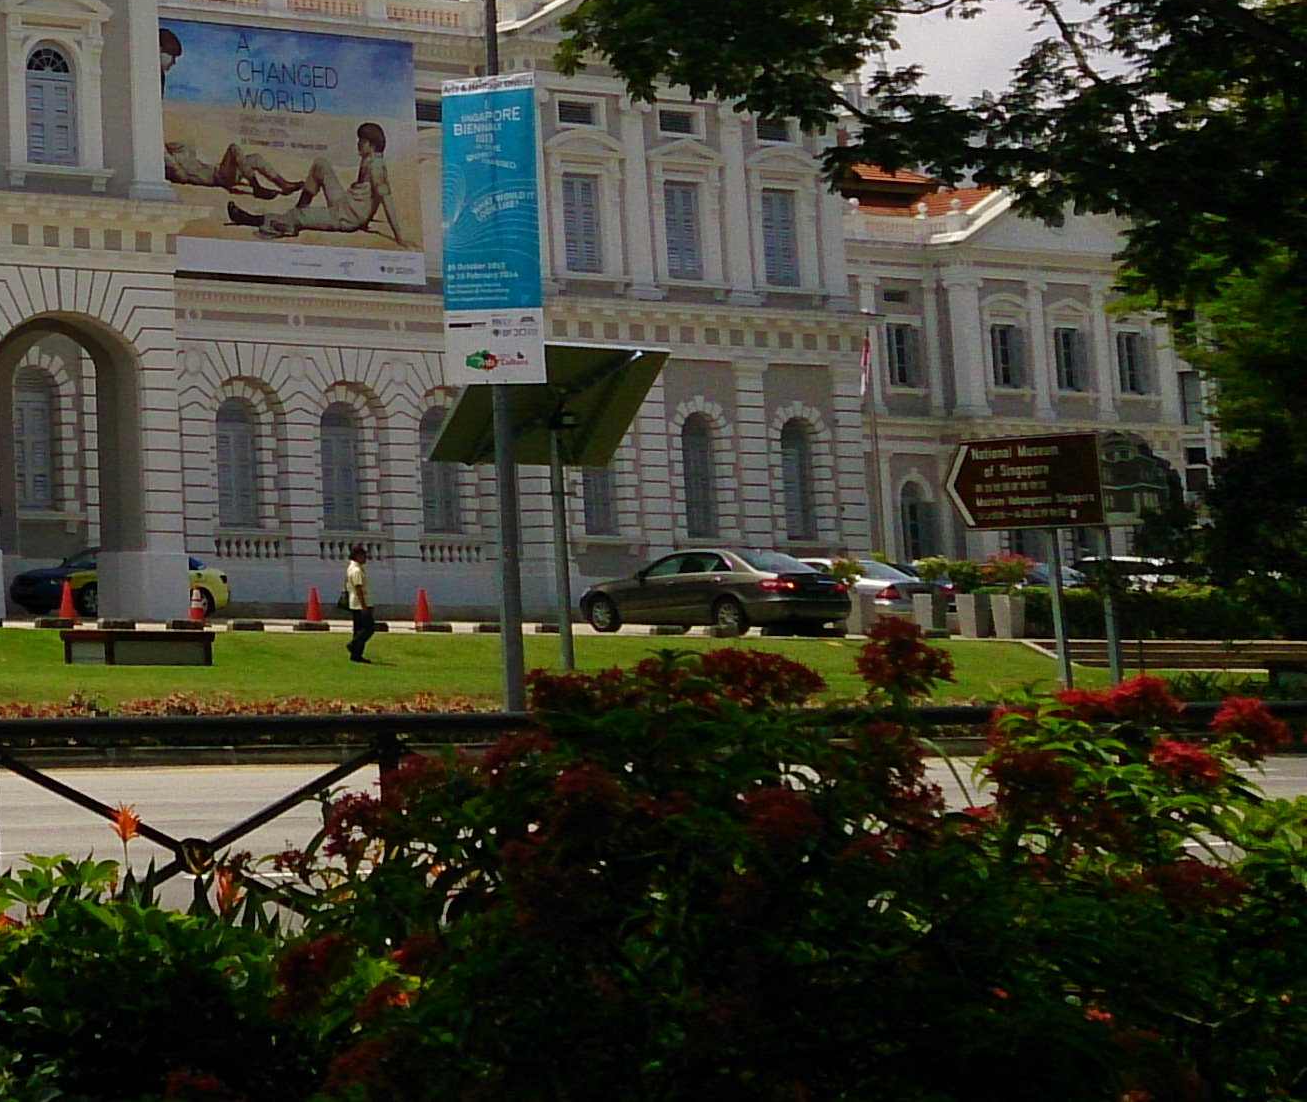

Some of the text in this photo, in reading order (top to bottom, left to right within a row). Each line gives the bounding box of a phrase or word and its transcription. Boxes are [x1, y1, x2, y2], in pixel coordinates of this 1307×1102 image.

[236, 32, 250, 54] A
[236, 59, 338, 89] CHANGED
[443, 85, 459, 93] Arts
[236, 86, 317, 114] WORLD
[971, 445, 1059, 460] National Museum
[984, 464, 1049, 479] of Singapore
